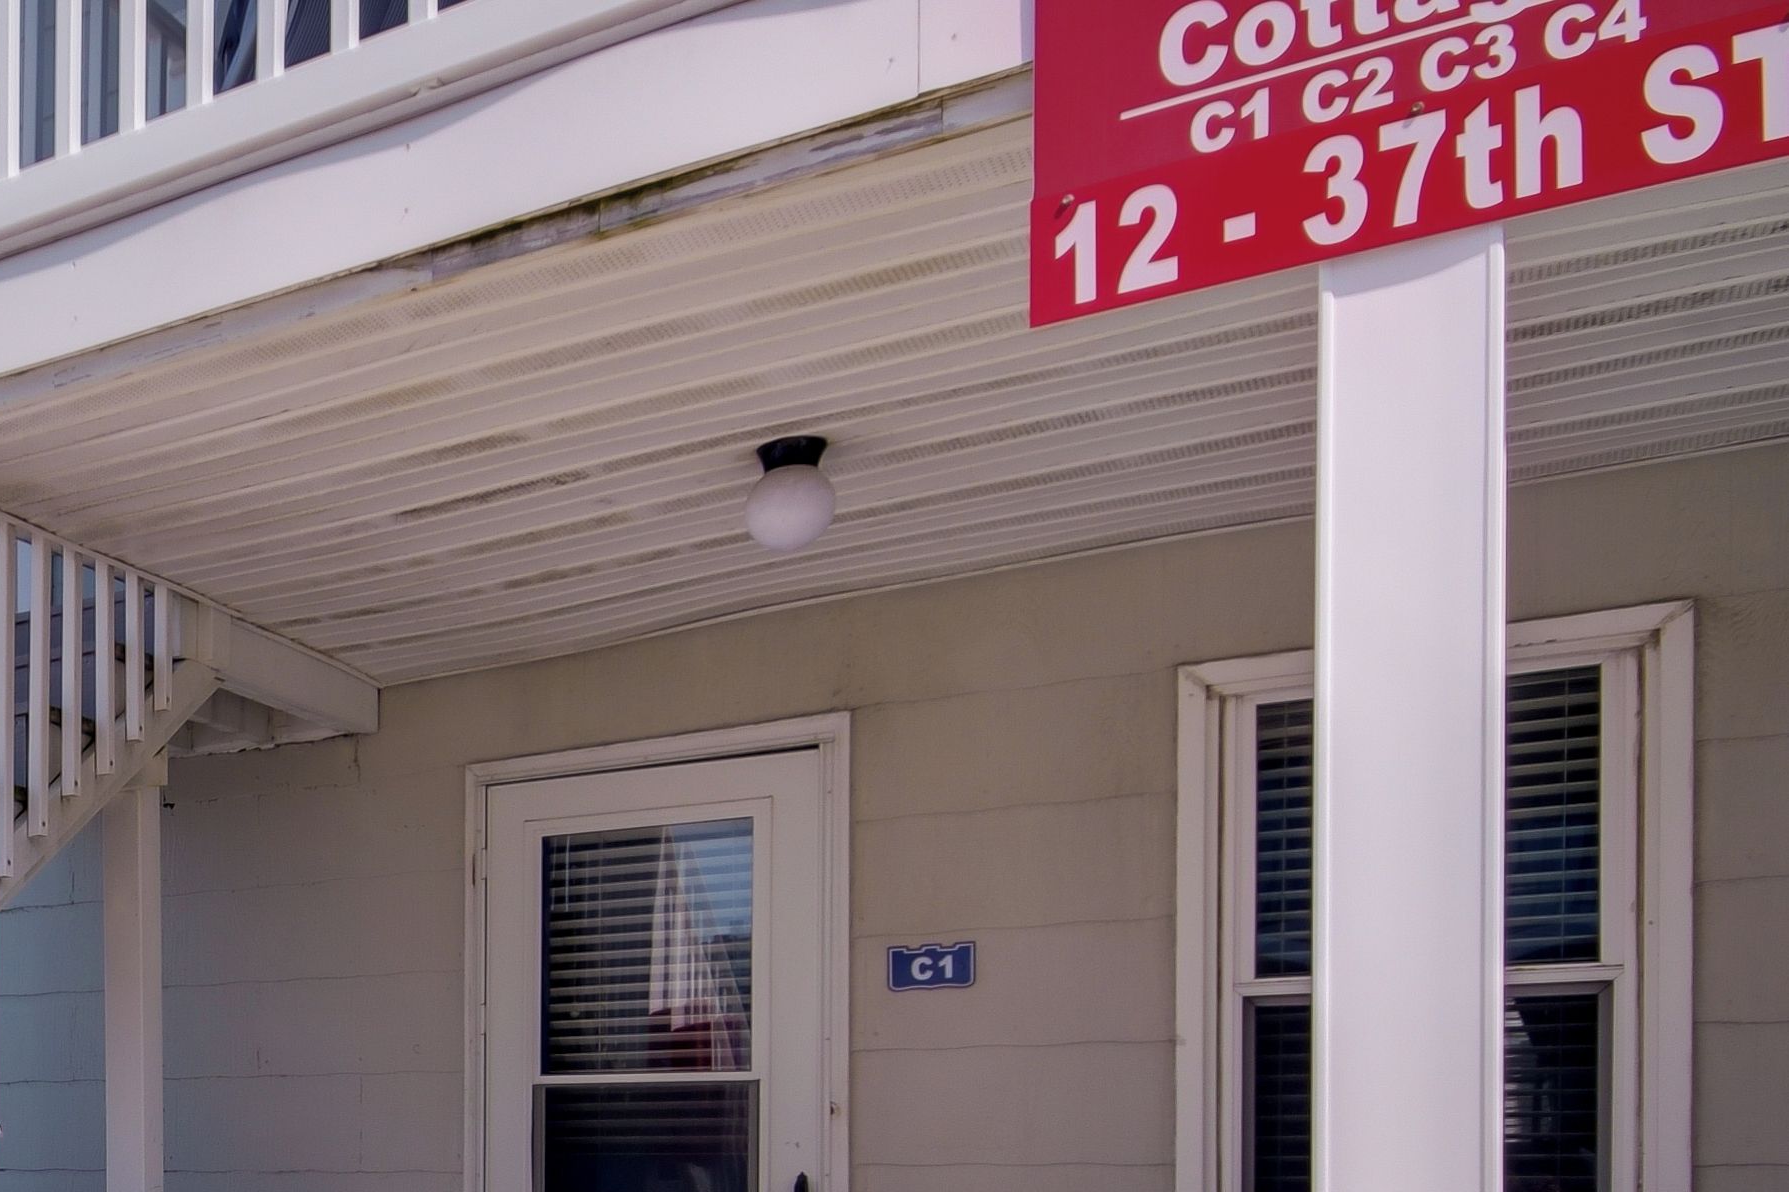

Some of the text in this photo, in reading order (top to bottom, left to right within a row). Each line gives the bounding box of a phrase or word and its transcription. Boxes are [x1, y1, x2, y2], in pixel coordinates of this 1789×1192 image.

[1190, 0, 1648, 153] C1 C2 C3 C4
[1054, 183, 1179, 305] 12
[1301, 84, 1583, 246] 37th
[1641, 22, 1789, 165] ST
[911, 954, 954, 981] C1
